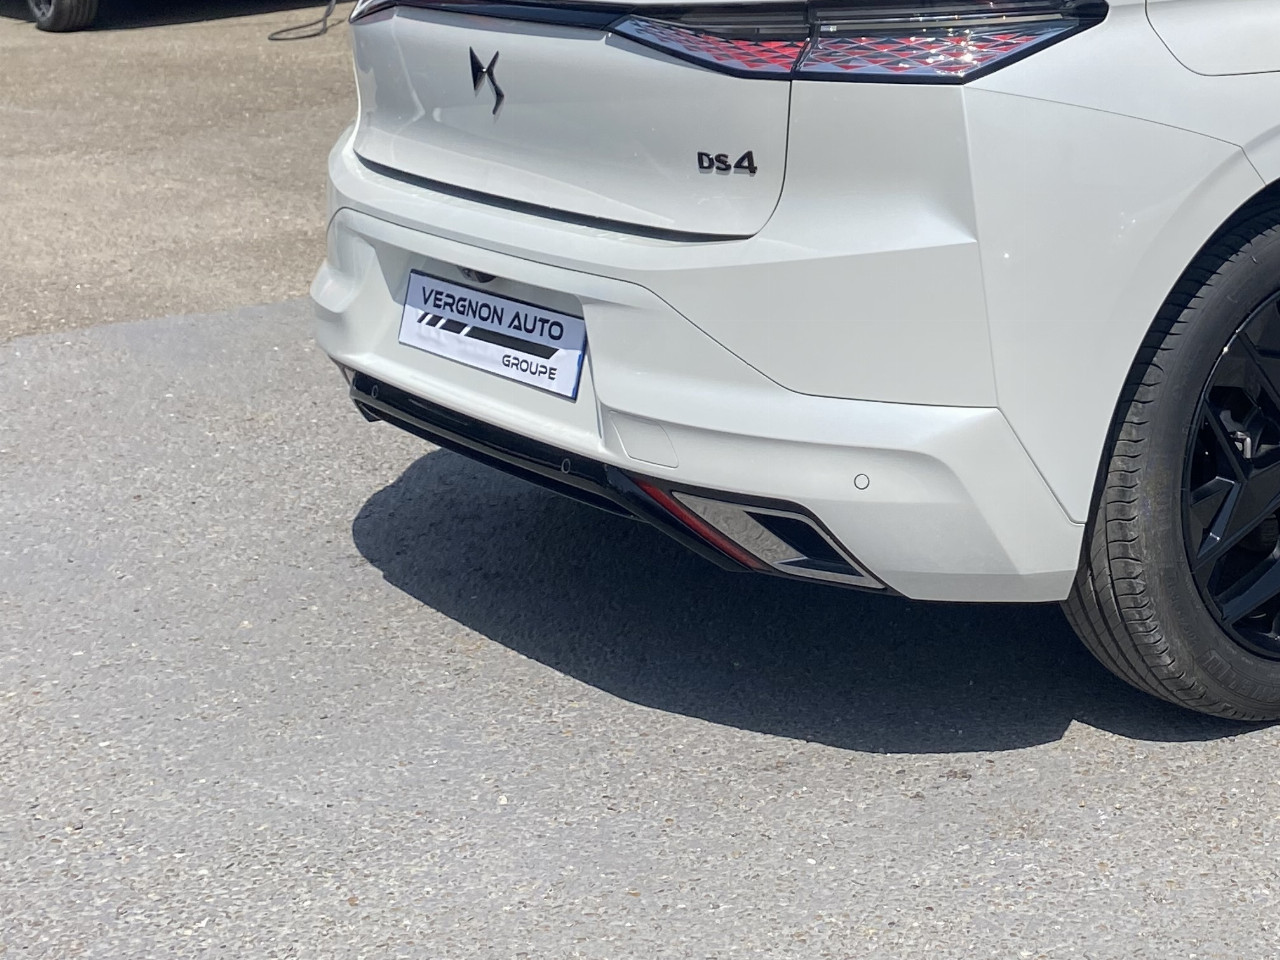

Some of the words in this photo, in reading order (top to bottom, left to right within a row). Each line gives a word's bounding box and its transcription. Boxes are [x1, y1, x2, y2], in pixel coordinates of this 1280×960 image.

[422, 286, 504, 326] VERGNON
[508, 311, 564, 341] AUTO
[502, 354, 558, 381] GROUPE
